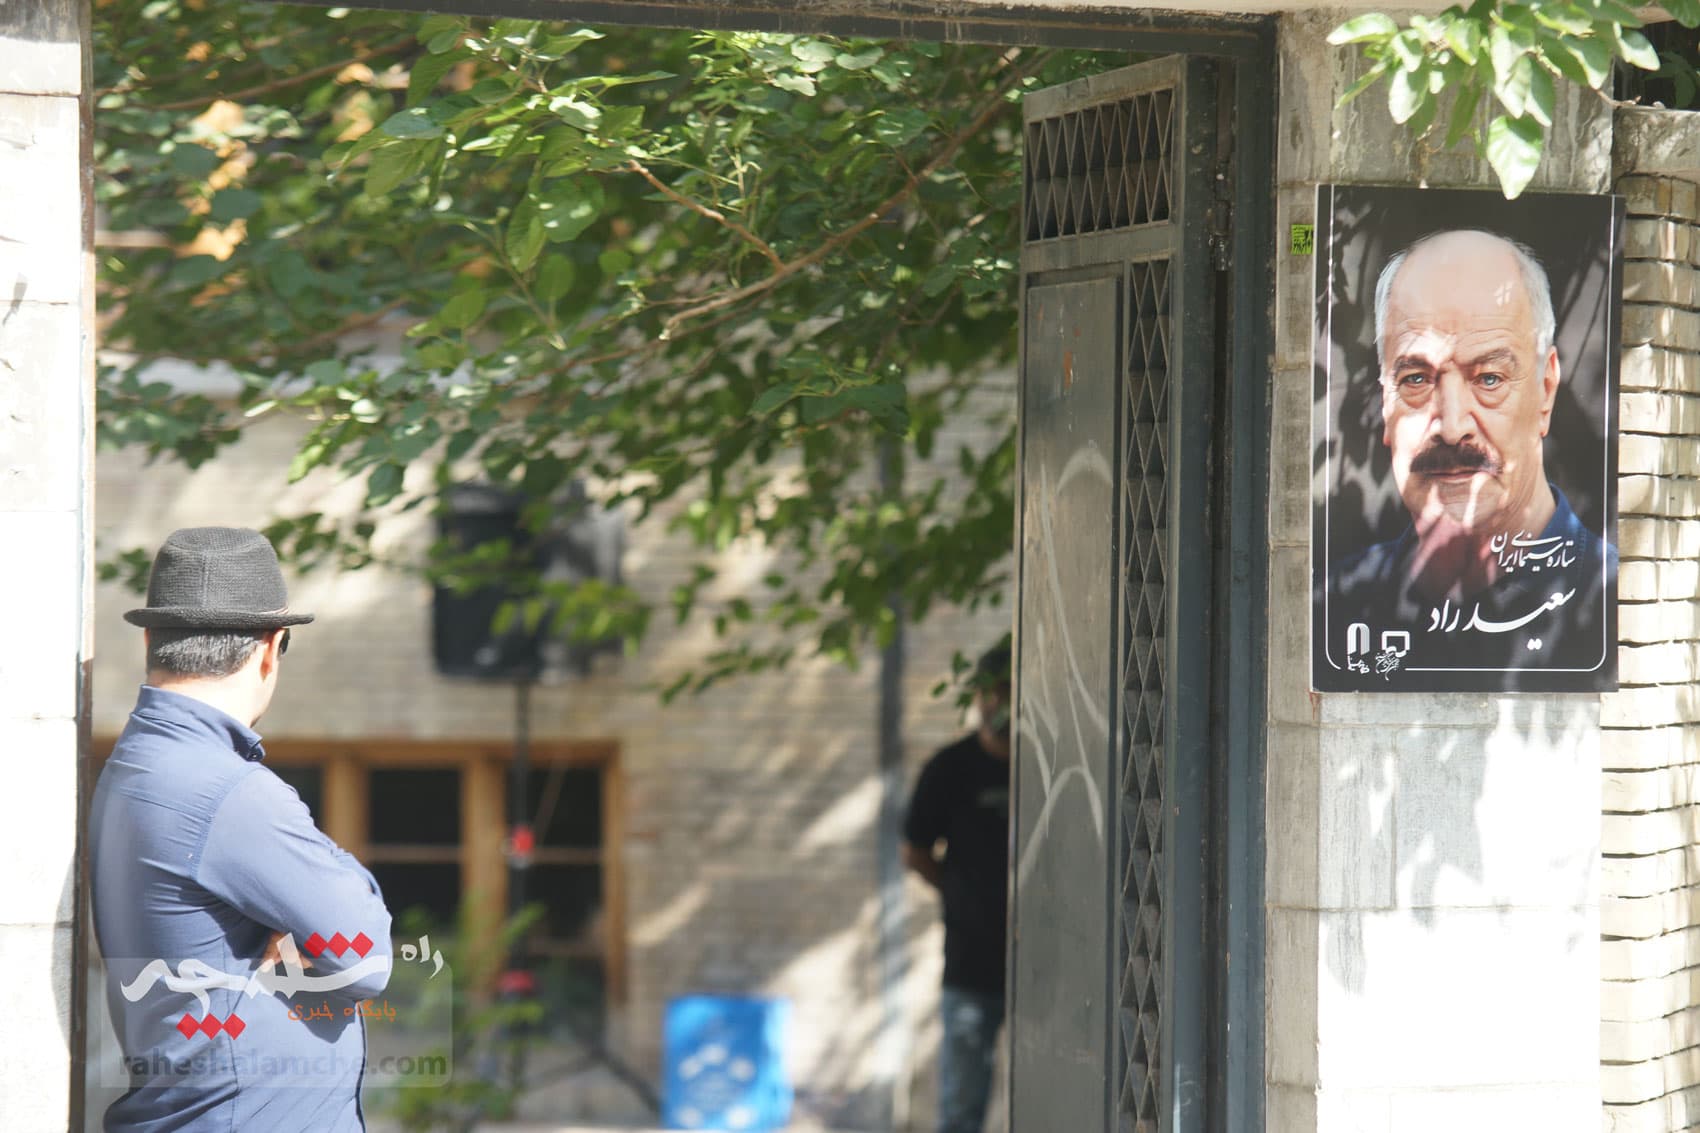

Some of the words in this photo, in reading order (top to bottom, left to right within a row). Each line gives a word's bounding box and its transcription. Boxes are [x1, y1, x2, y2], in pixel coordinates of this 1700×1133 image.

[1490, 531, 1519, 573] ایران
[1547, 540, 1577, 568] ستاره
[1427, 599, 1461, 633] راد
[1461, 587, 1577, 651] سعید
